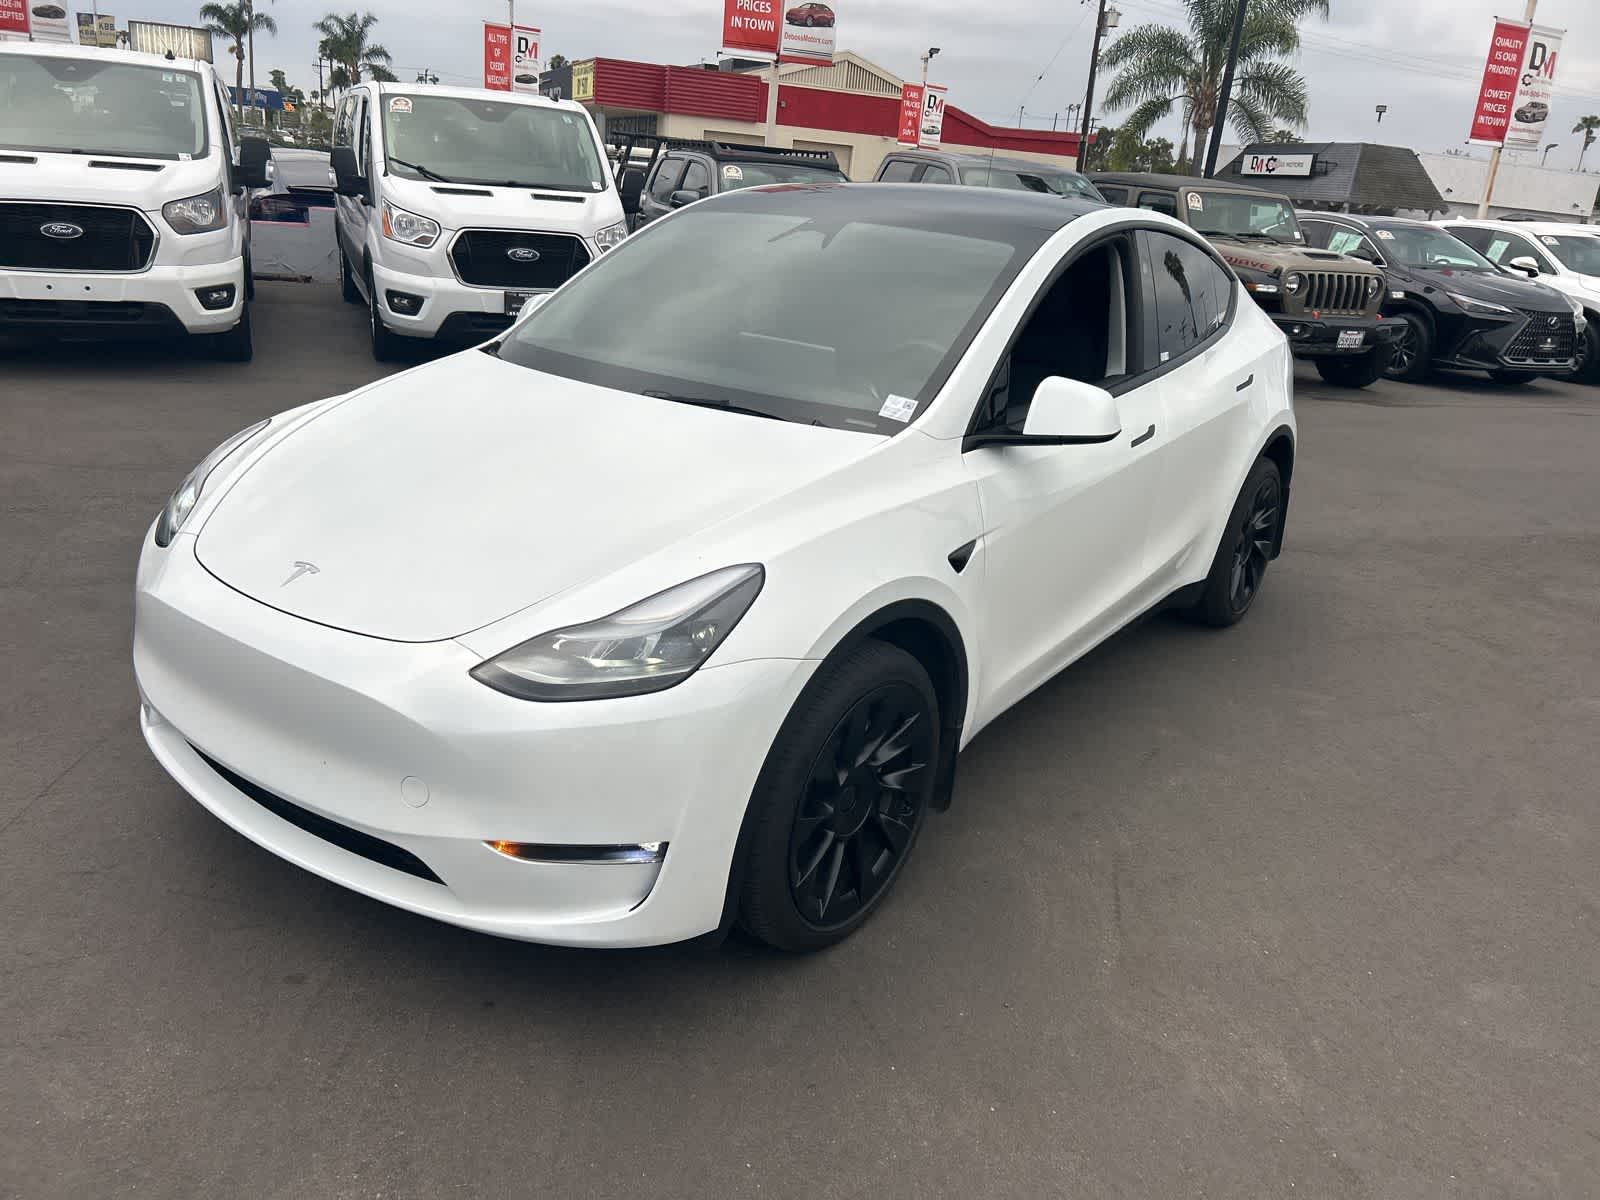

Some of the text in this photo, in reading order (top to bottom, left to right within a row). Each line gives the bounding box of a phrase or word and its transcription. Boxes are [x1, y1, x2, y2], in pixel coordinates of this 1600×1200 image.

[737, 0, 772, 14] PRICES
[731, 15, 775, 32] IN TOWN
[488, 33, 508, 45] ALL TYPE
[1495, 36, 1523, 50] QUALITY
[494, 47, 502, 57] OF
[1495, 51, 1517, 63] IS OUR
[489, 61, 505, 72] CREDIT
[1488, 63, 1517, 77] PRIORITY
[1484, 88, 1512, 99] LOWEST
[903, 100, 921, 108] TRUCKS
[1483, 103, 1507, 113] PRICES
[904, 110, 917, 118] VANS
[1477, 115, 1506, 127] IN TOWN
[1223, 256, 1273, 269] OJAVE
